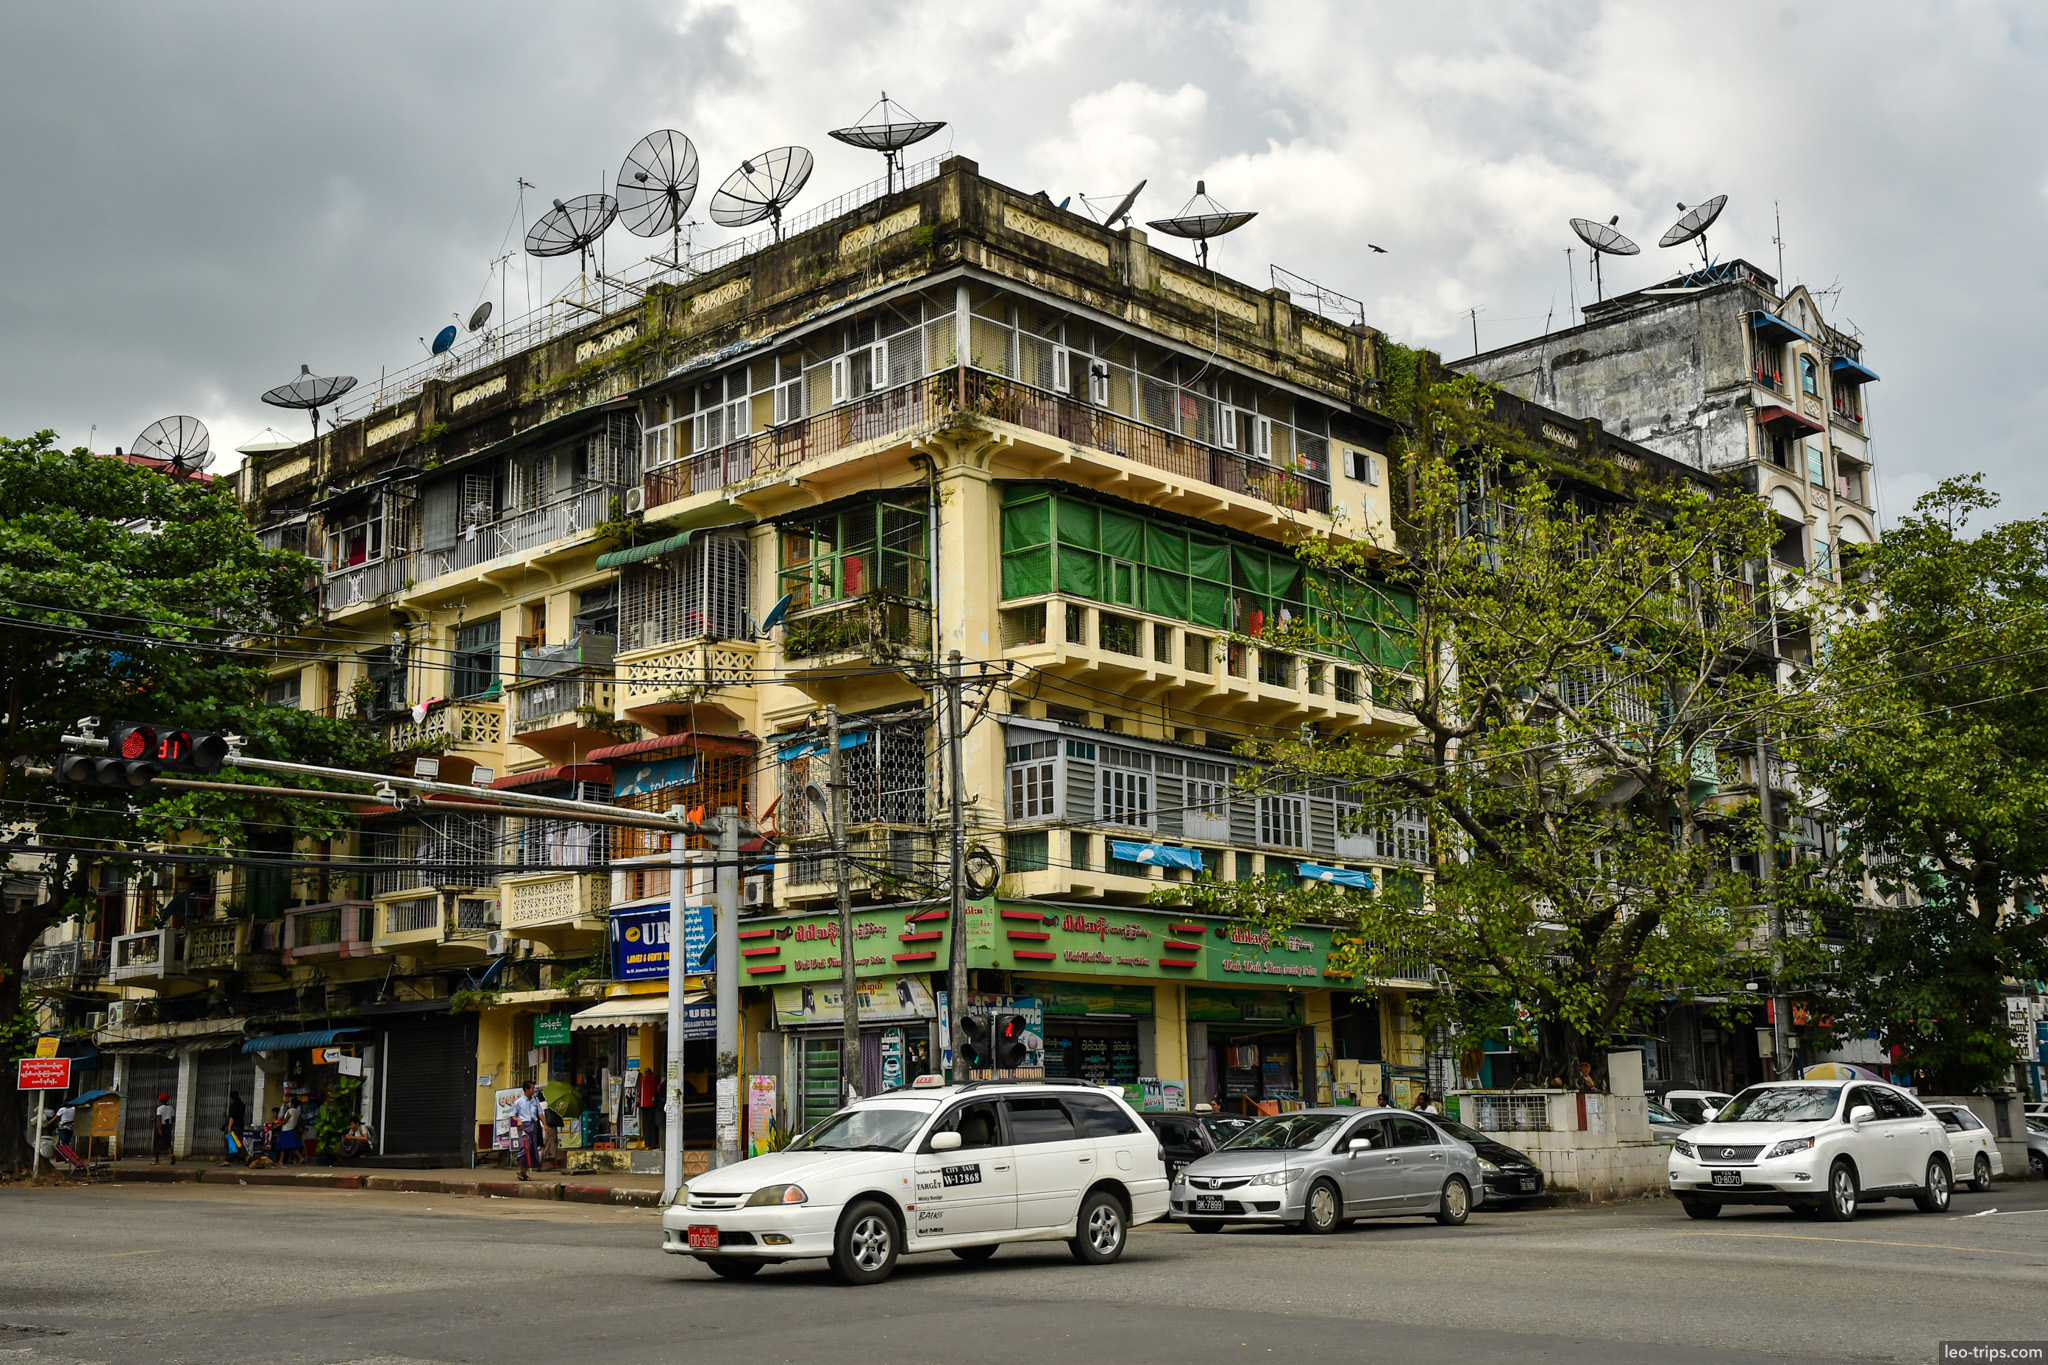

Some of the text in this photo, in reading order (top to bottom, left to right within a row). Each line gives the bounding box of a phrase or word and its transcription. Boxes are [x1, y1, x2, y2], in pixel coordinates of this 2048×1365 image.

[641, 921, 670, 945] UR
[916, 1179, 942, 1190] TARGET
[943, 1172, 980, 1186] W-12868
